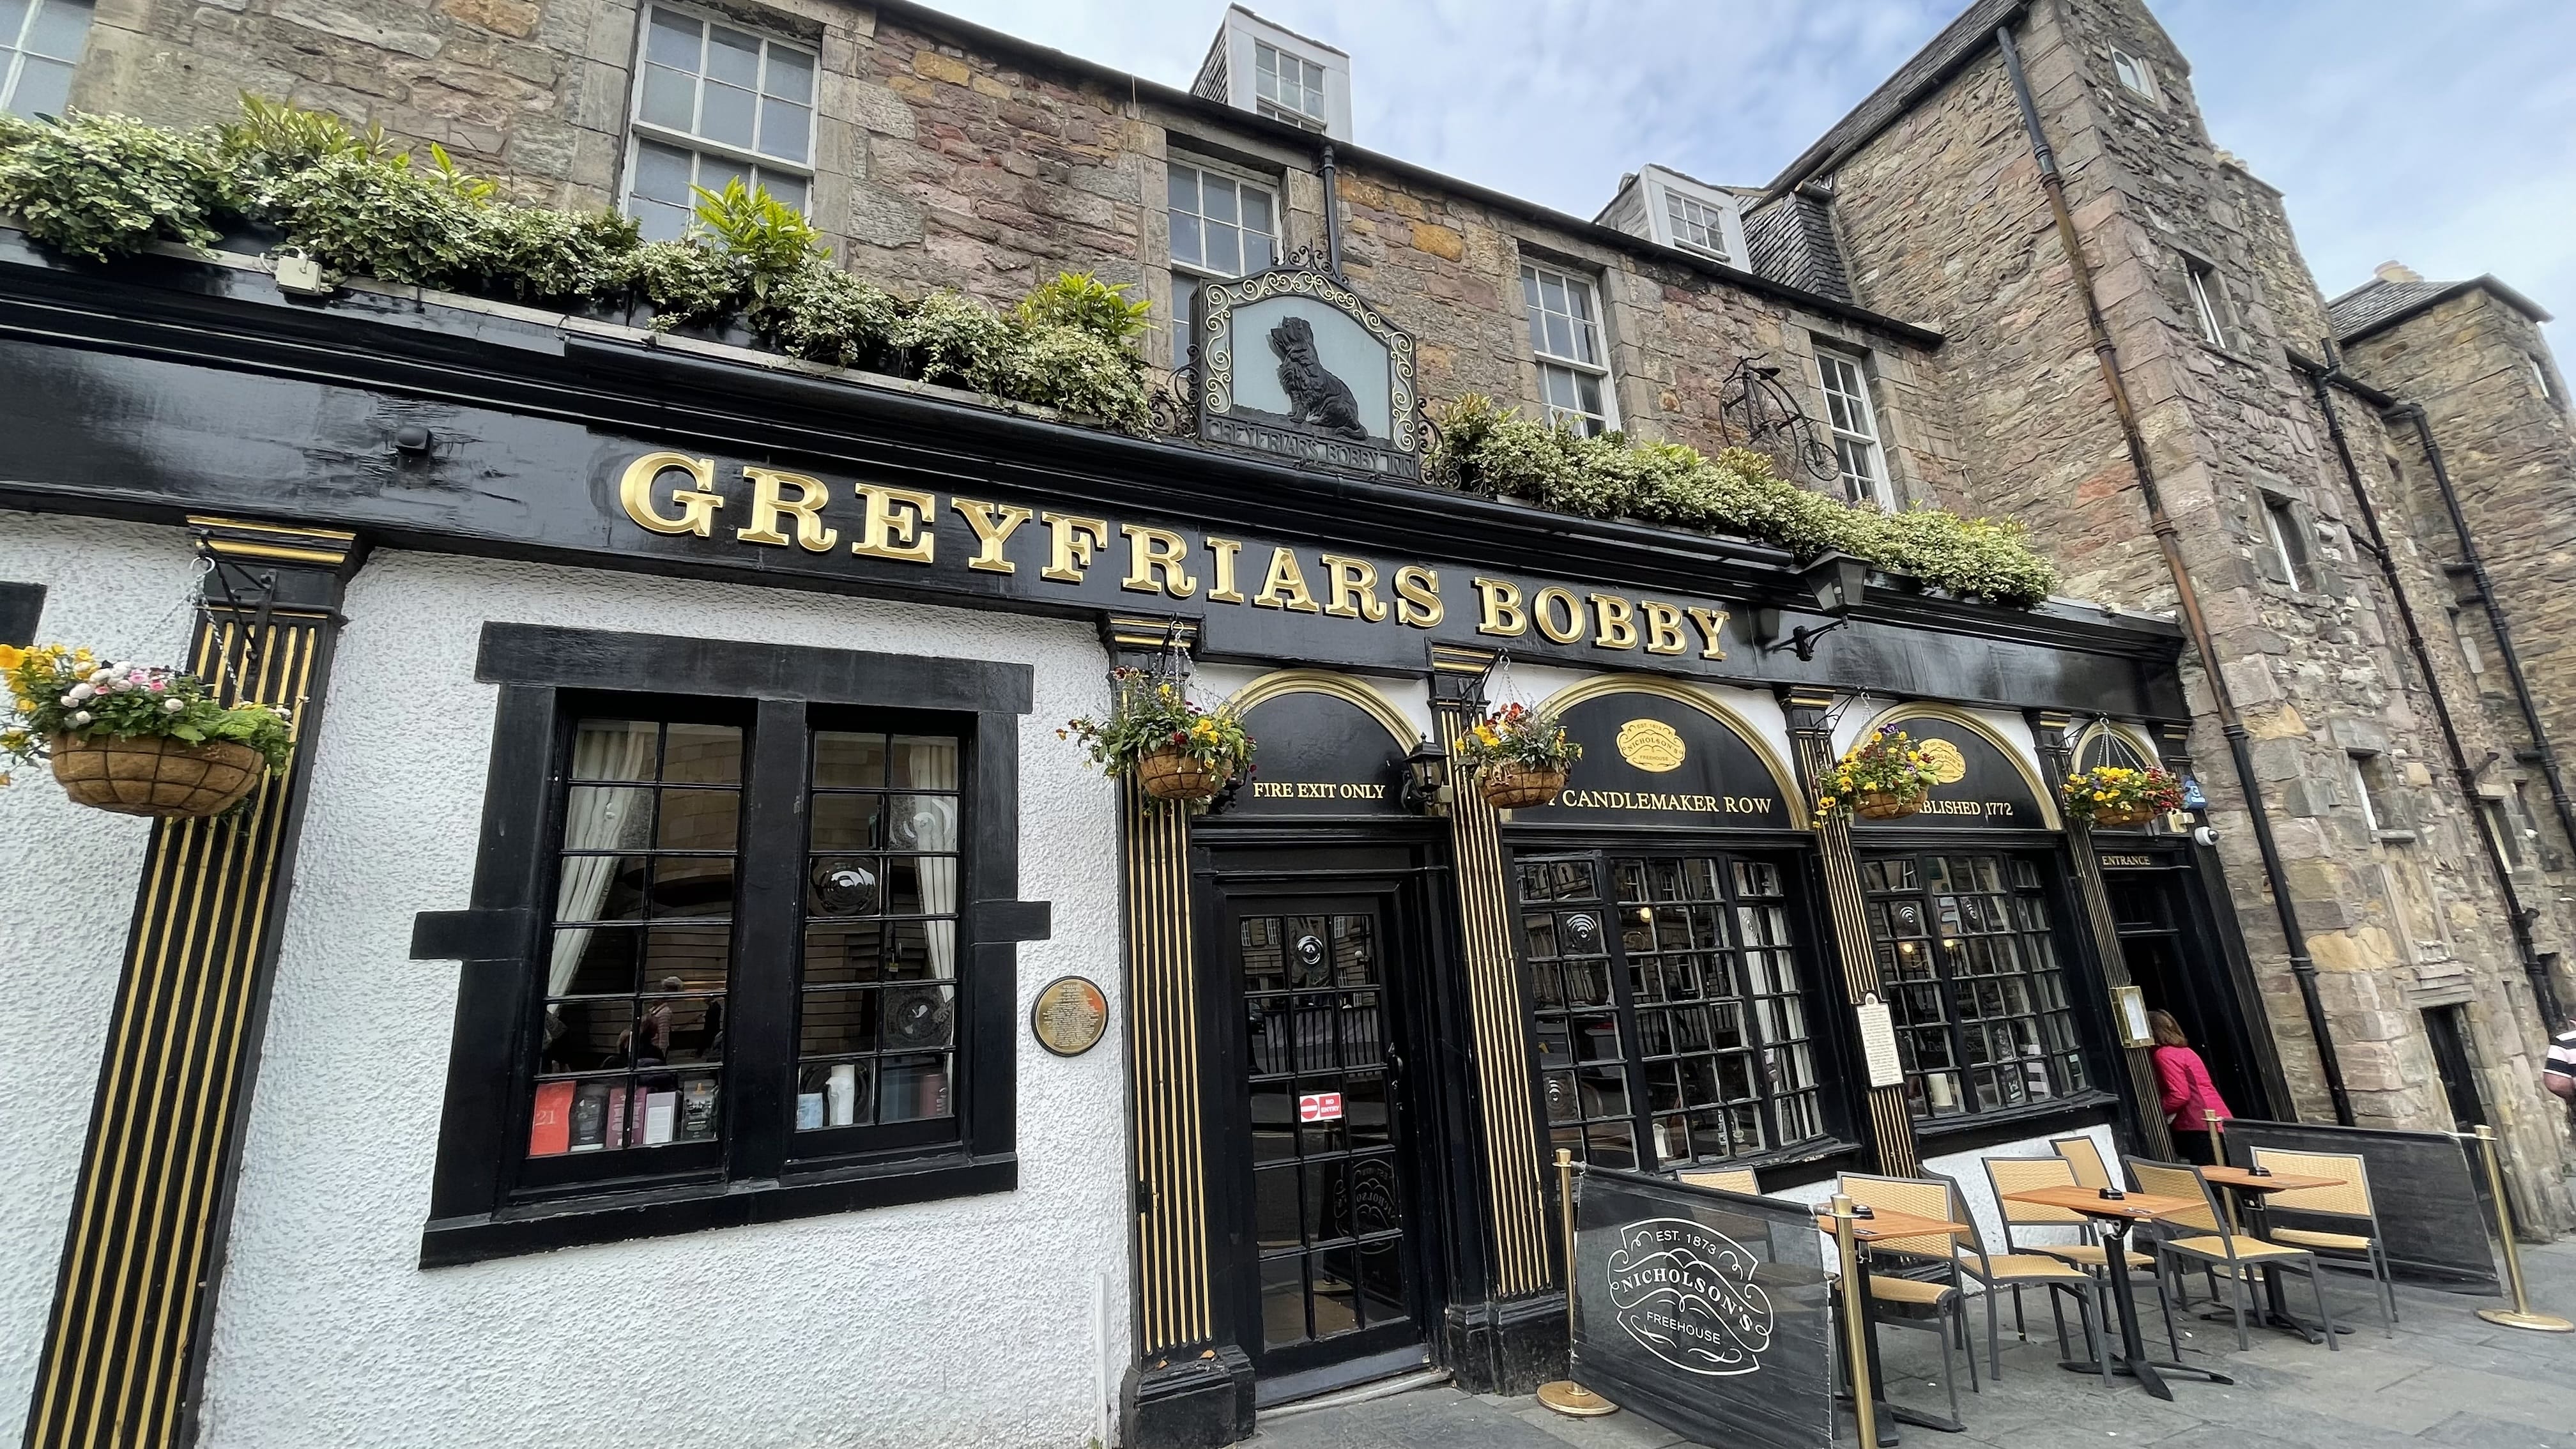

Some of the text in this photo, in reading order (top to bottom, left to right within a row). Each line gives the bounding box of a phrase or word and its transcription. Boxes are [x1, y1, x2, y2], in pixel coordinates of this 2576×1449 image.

[1208, 420, 1416, 477] GREYFRIARS BOBBY INN
[620, 451, 1730, 660] GREYFRIARS BOBBY
[1628, 737, 1678, 754] NICHOLSON'S
[1253, 783, 1386, 798] FIRE EXIT ONLY
[1562, 790, 1719, 812] CANDLEMAKER
[1723, 797, 1772, 813] ROW
[1919, 801, 2013, 815] BLISHED 1772
[2102, 855, 2151, 866] ENTRANCE
[535, 1110, 556, 1126] 21
[1321, 1105, 1340, 1114] ENTRY
[1655, 1230, 1717, 1255] EST. 1873
[1620, 1267, 1754, 1332] NICHOLSON'S
[1646, 1311, 1721, 1345] FREEHOUSE
